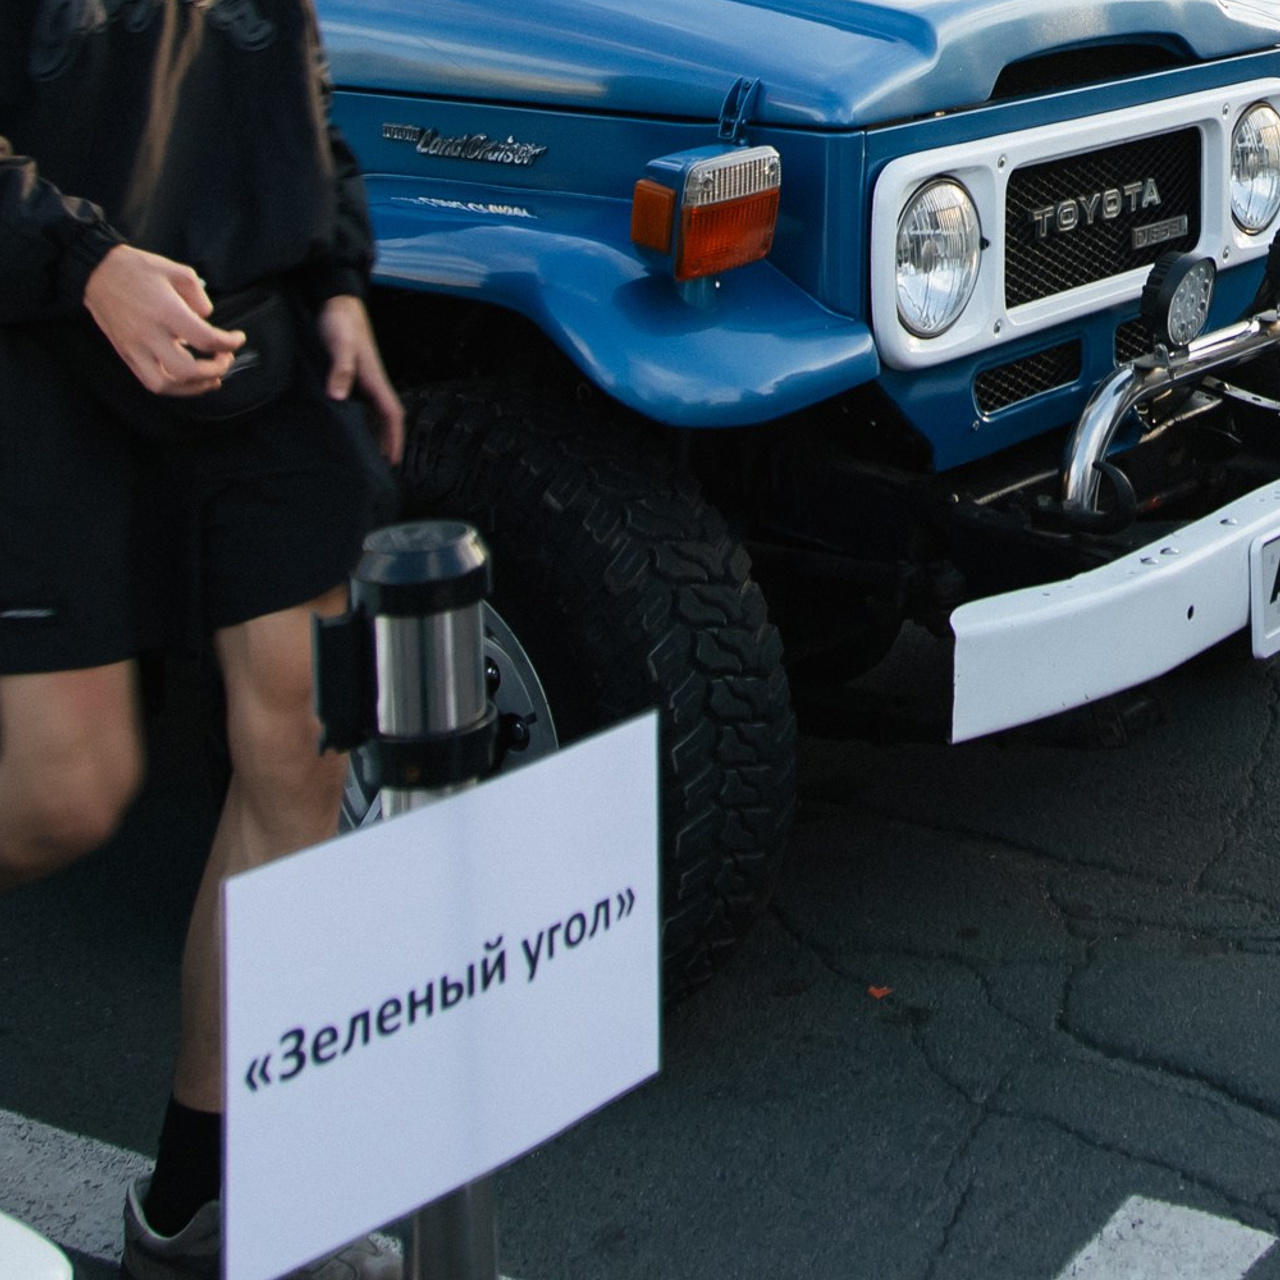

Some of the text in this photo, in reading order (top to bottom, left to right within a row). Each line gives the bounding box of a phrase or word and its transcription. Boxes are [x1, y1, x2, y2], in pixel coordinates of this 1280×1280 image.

[1029, 177, 1163, 239] TOYOTA
[243, 886, 637, 1093] «Зеленый угол»
